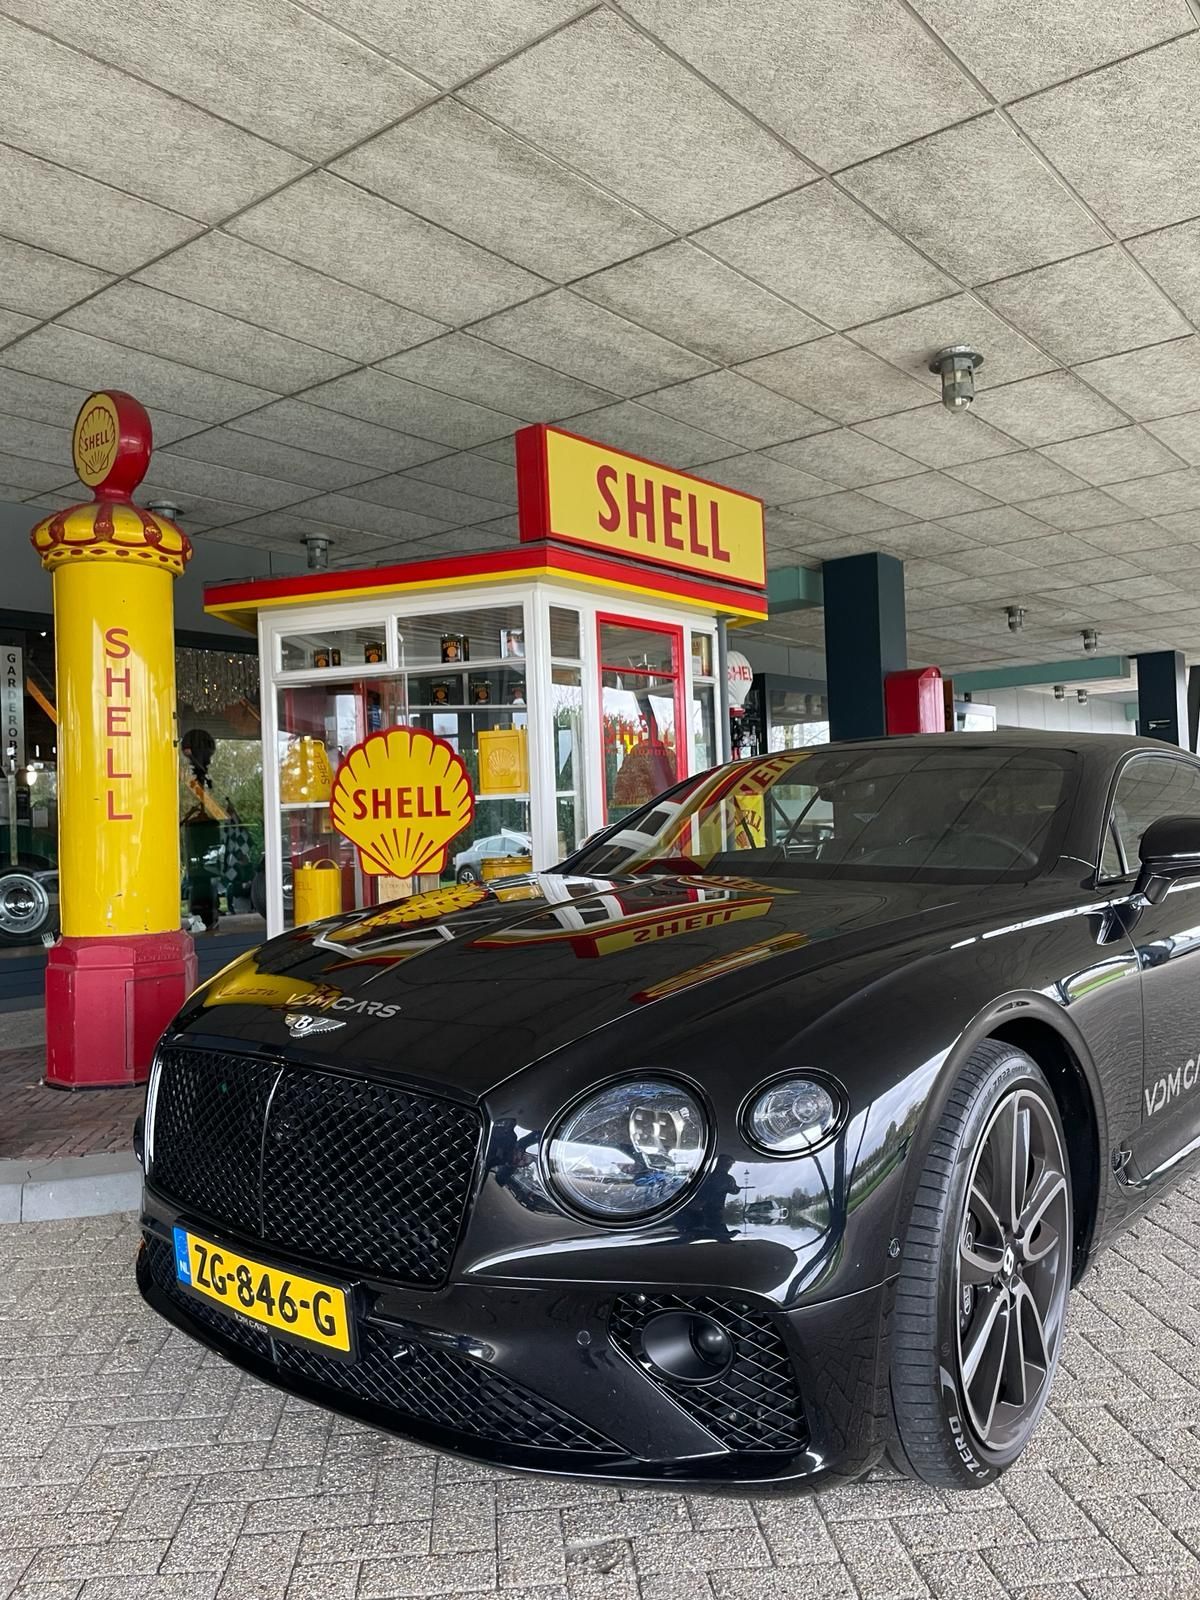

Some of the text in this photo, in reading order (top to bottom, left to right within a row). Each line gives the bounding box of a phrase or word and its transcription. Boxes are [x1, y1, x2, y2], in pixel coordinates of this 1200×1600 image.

[84, 430, 110, 451] SHELL
[596, 464, 731, 563] SHELL
[105, 628, 133, 820] SHELL
[352, 785, 451, 820] SHELL
[180, 1260, 190, 1276] NL
[194, 1244, 336, 1337] ZG-846-G
[948, 1416, 990, 1479] P ZERO
